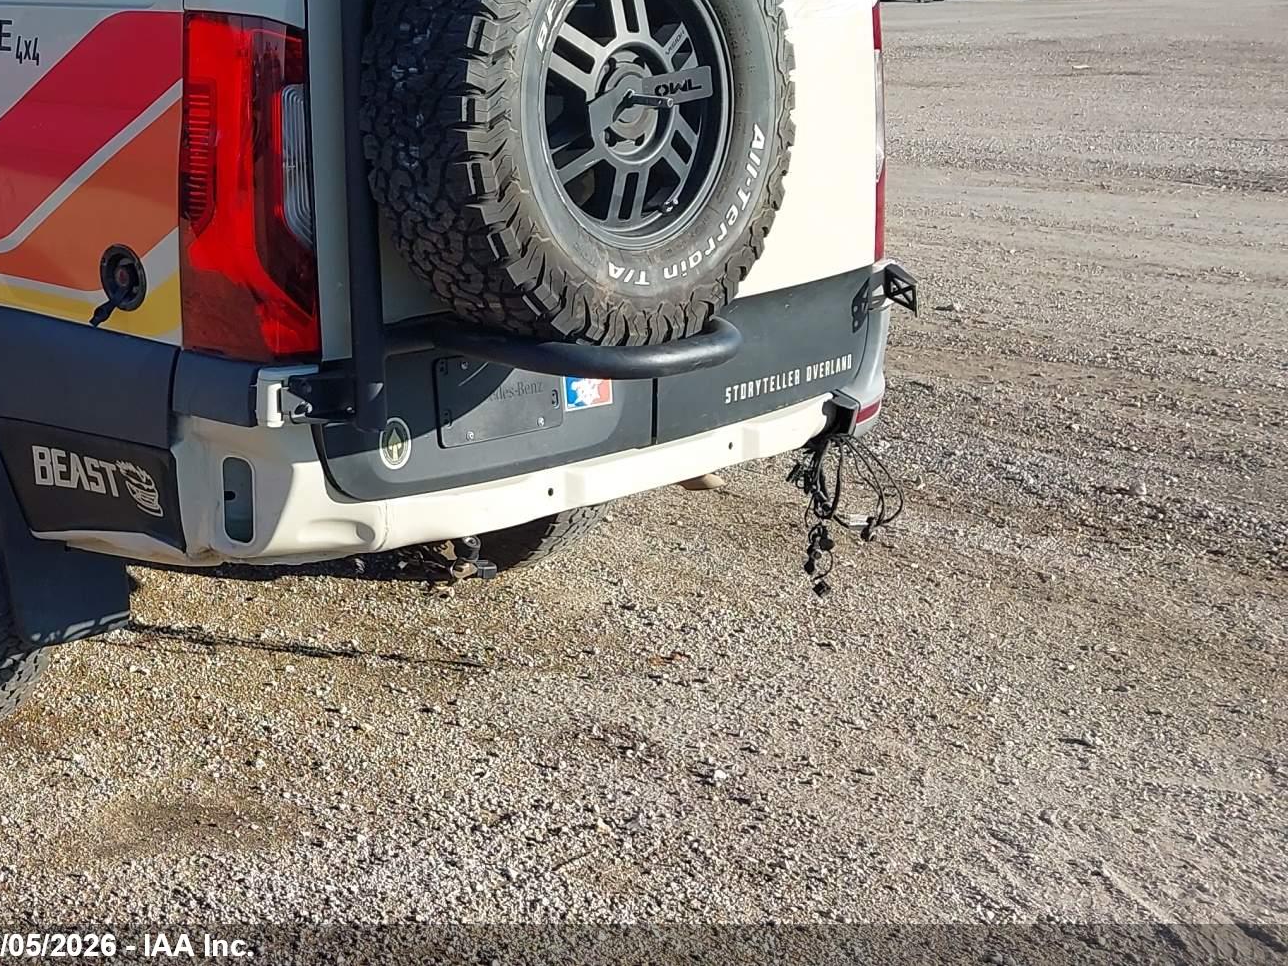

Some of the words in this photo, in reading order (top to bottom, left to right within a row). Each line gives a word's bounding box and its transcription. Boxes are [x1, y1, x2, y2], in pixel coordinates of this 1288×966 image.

[15, 35, 40, 66] 4x4
[654, 78, 702, 96] OWL
[663, 122, 766, 280] All-Terrain
[608, 261, 650, 285] T/A
[725, 369, 800, 404] STORYTELLER
[806, 353, 852, 382] OVERLAND
[32, 445, 120, 497] BEAST
